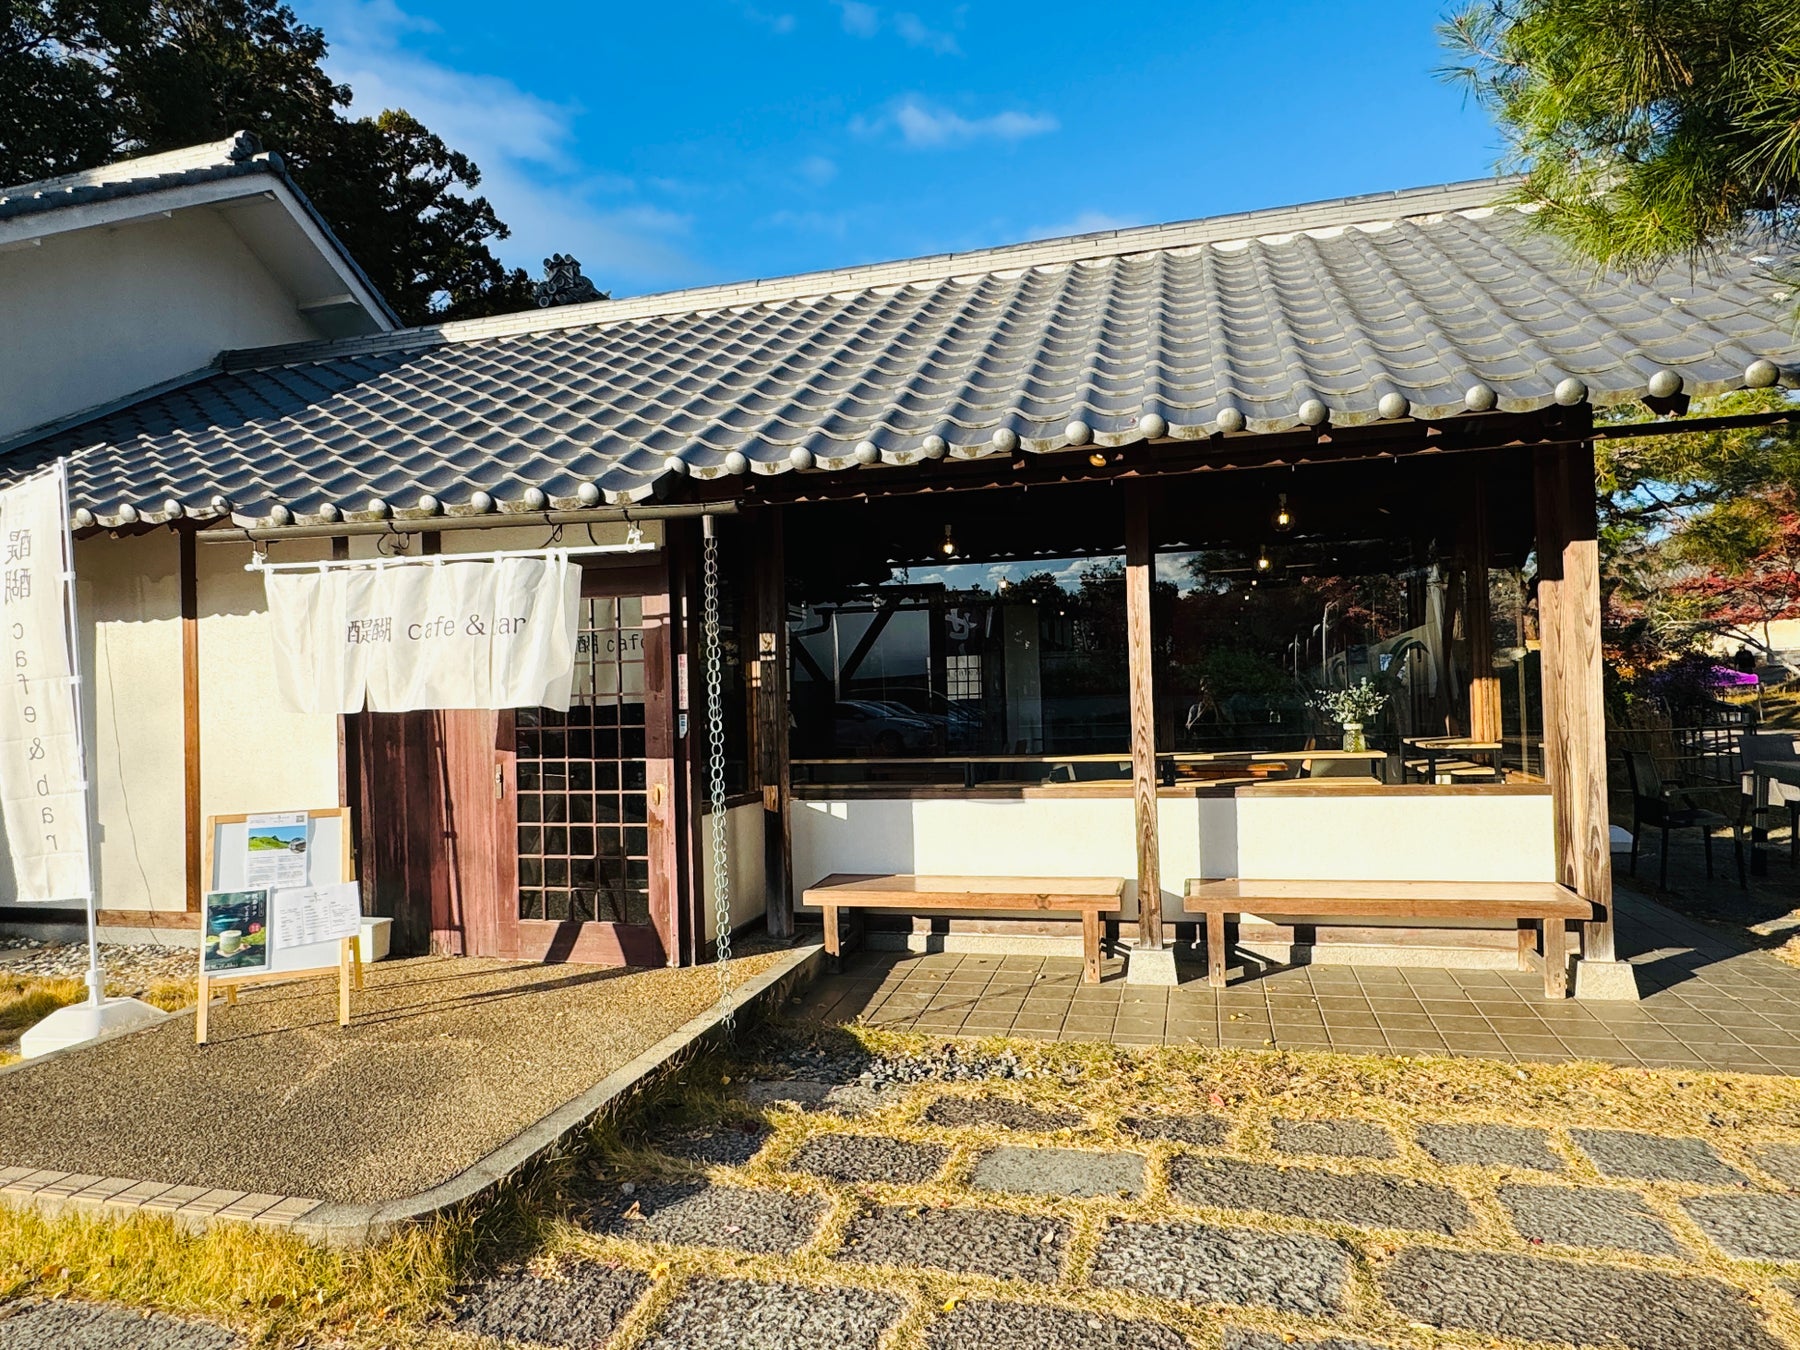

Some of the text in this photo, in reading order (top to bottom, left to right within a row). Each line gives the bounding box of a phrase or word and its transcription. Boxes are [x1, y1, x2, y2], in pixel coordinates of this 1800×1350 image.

[347, 613, 527, 645] 醍醐 cafe & ar
